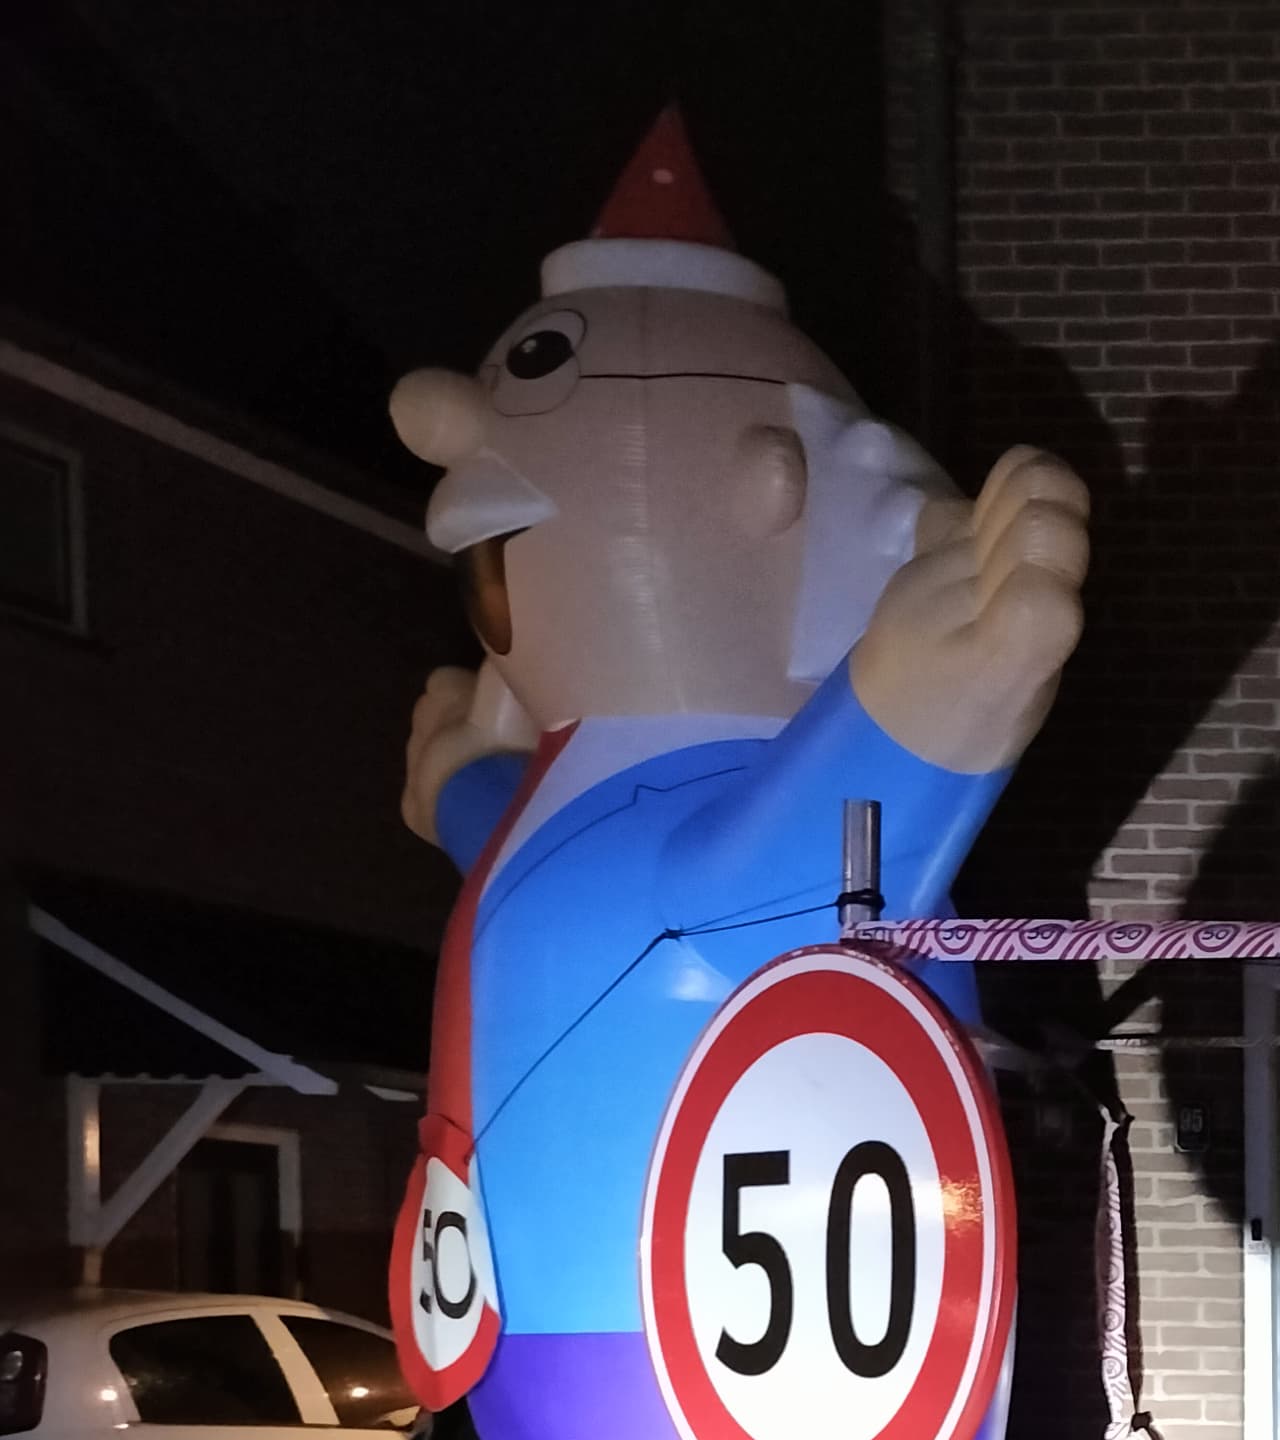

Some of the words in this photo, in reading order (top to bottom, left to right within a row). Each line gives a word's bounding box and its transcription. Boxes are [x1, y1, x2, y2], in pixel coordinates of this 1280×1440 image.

[1027, 926, 1052, 940] 50
[1114, 928, 1141, 940] 50
[1202, 927, 1230, 940] 50
[715, 1140, 917, 1378] 50
